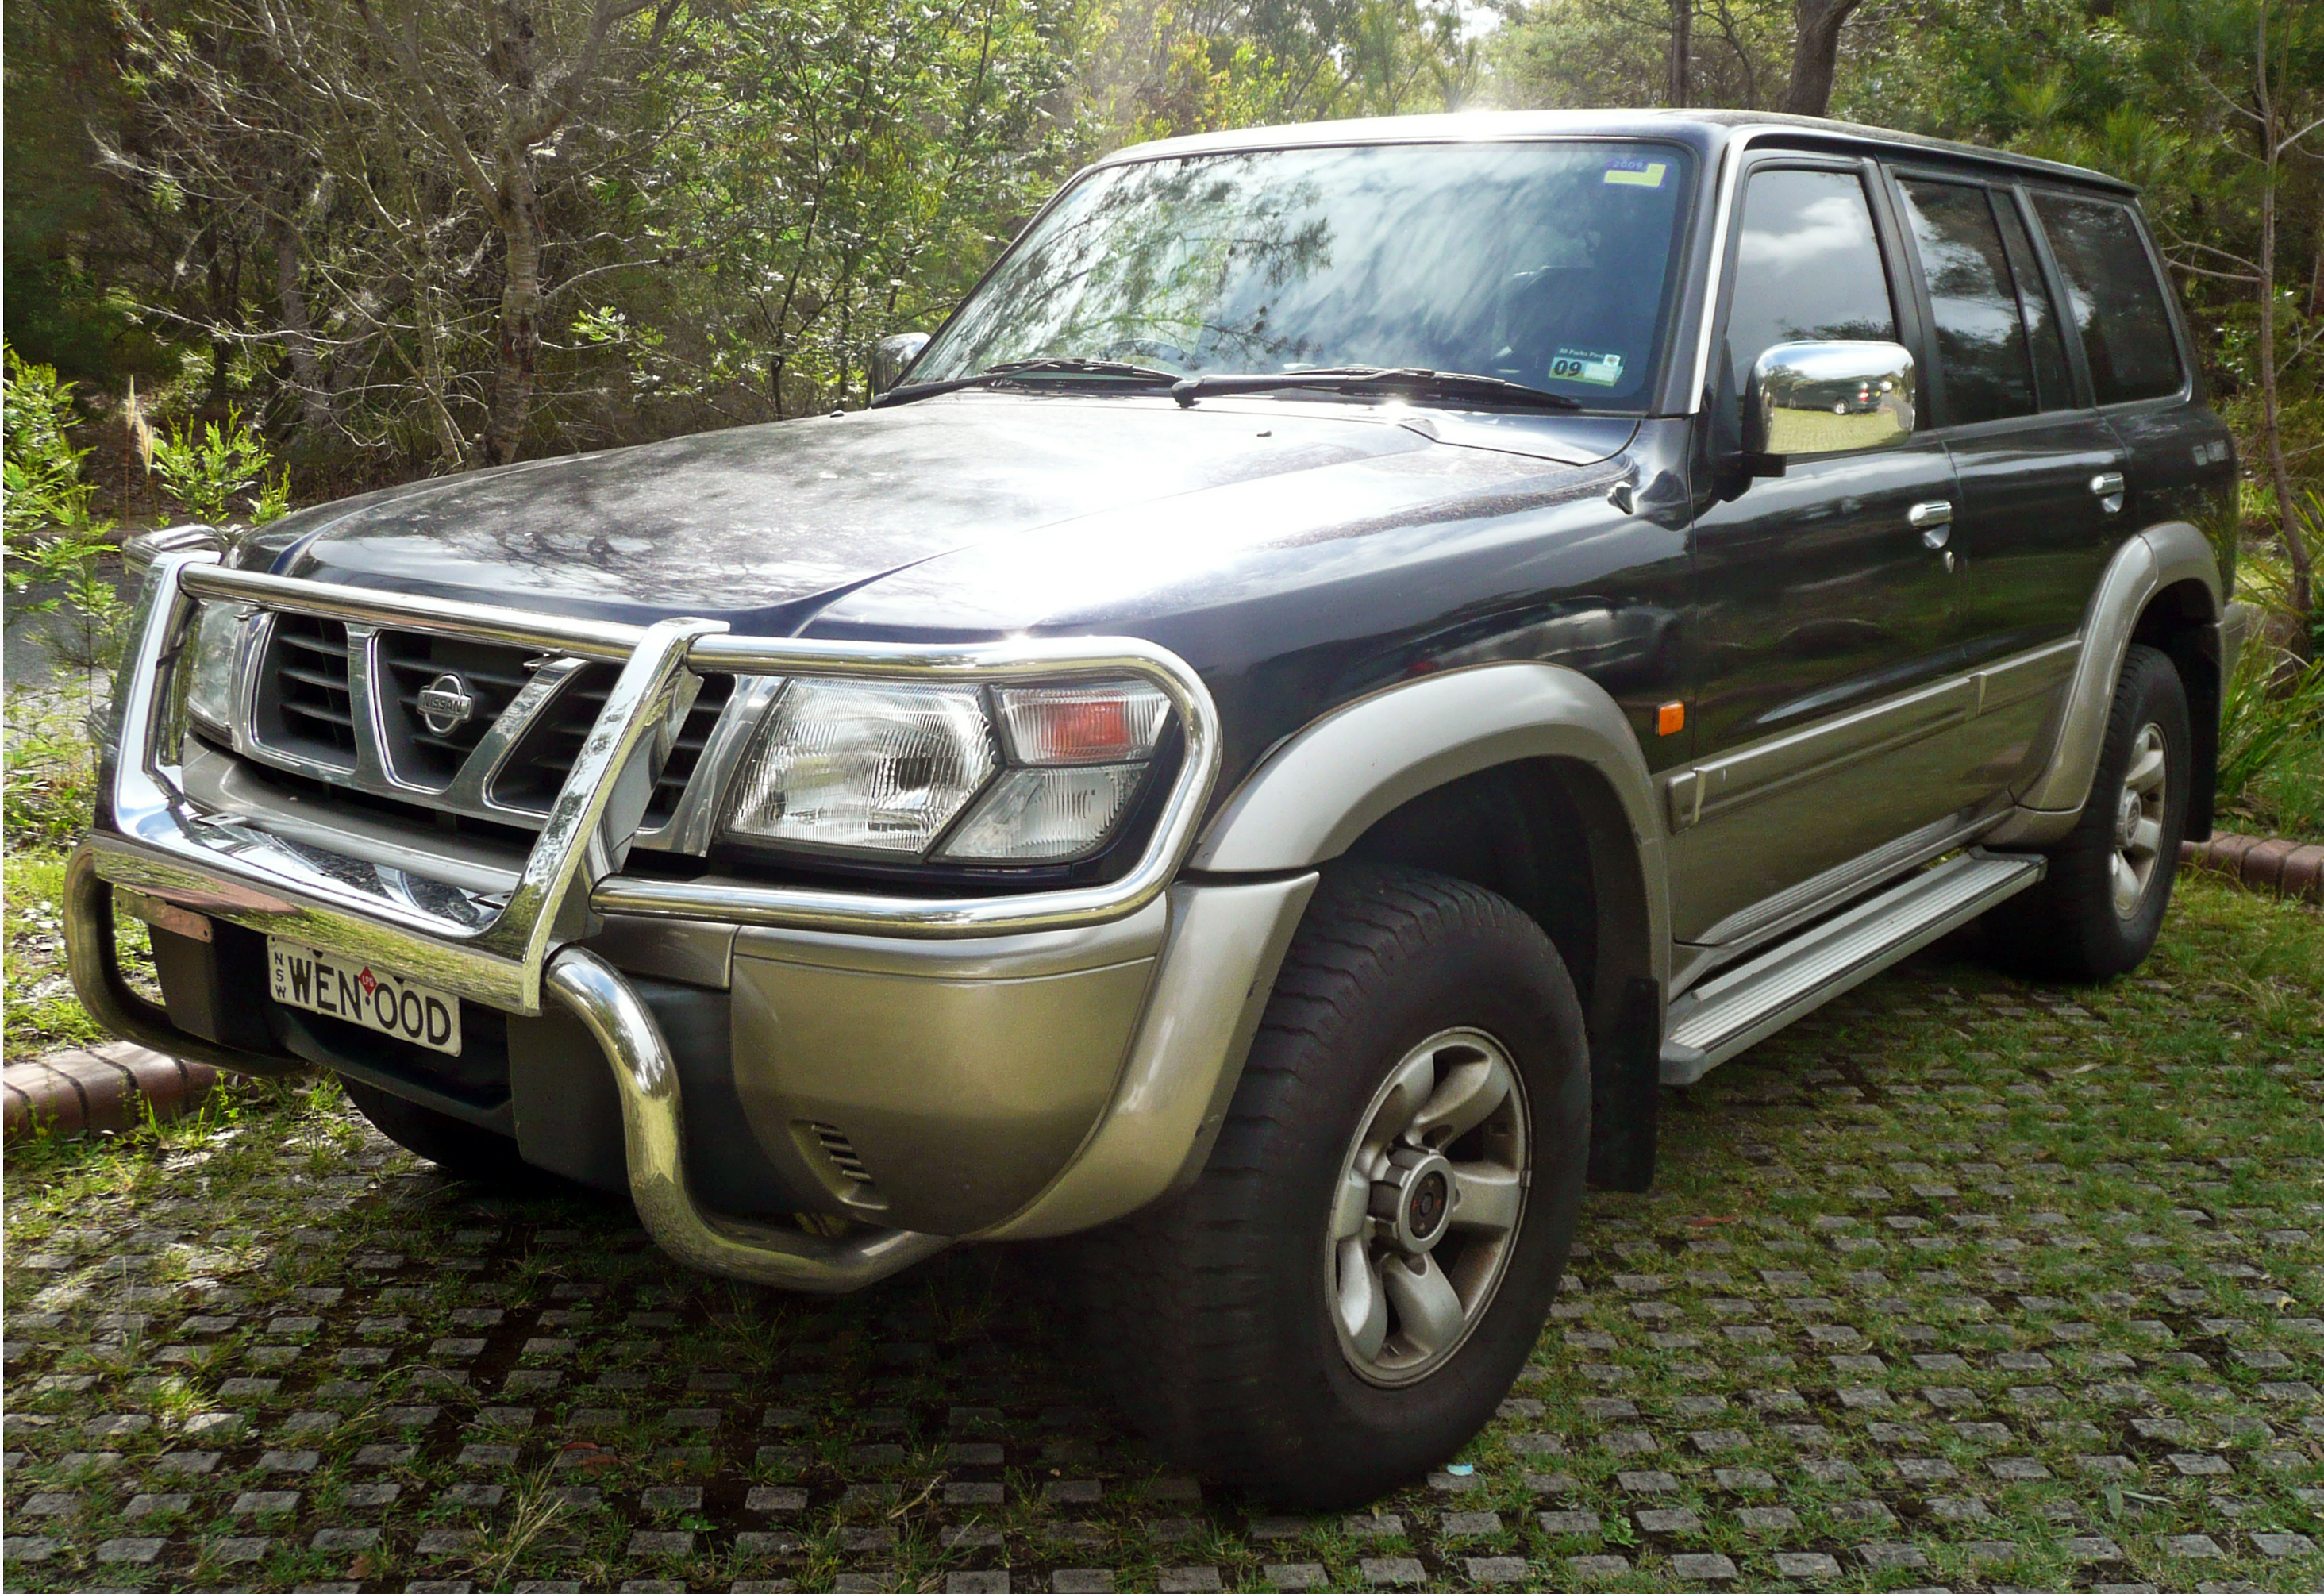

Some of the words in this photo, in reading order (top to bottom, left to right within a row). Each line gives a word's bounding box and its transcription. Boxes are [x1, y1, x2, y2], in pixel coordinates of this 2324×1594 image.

[1613, 161, 1643, 170] 2009
[1554, 360, 1582, 376] 09
[421, 695, 462, 714] NISSAN
[362, 975, 374, 987] LPG
